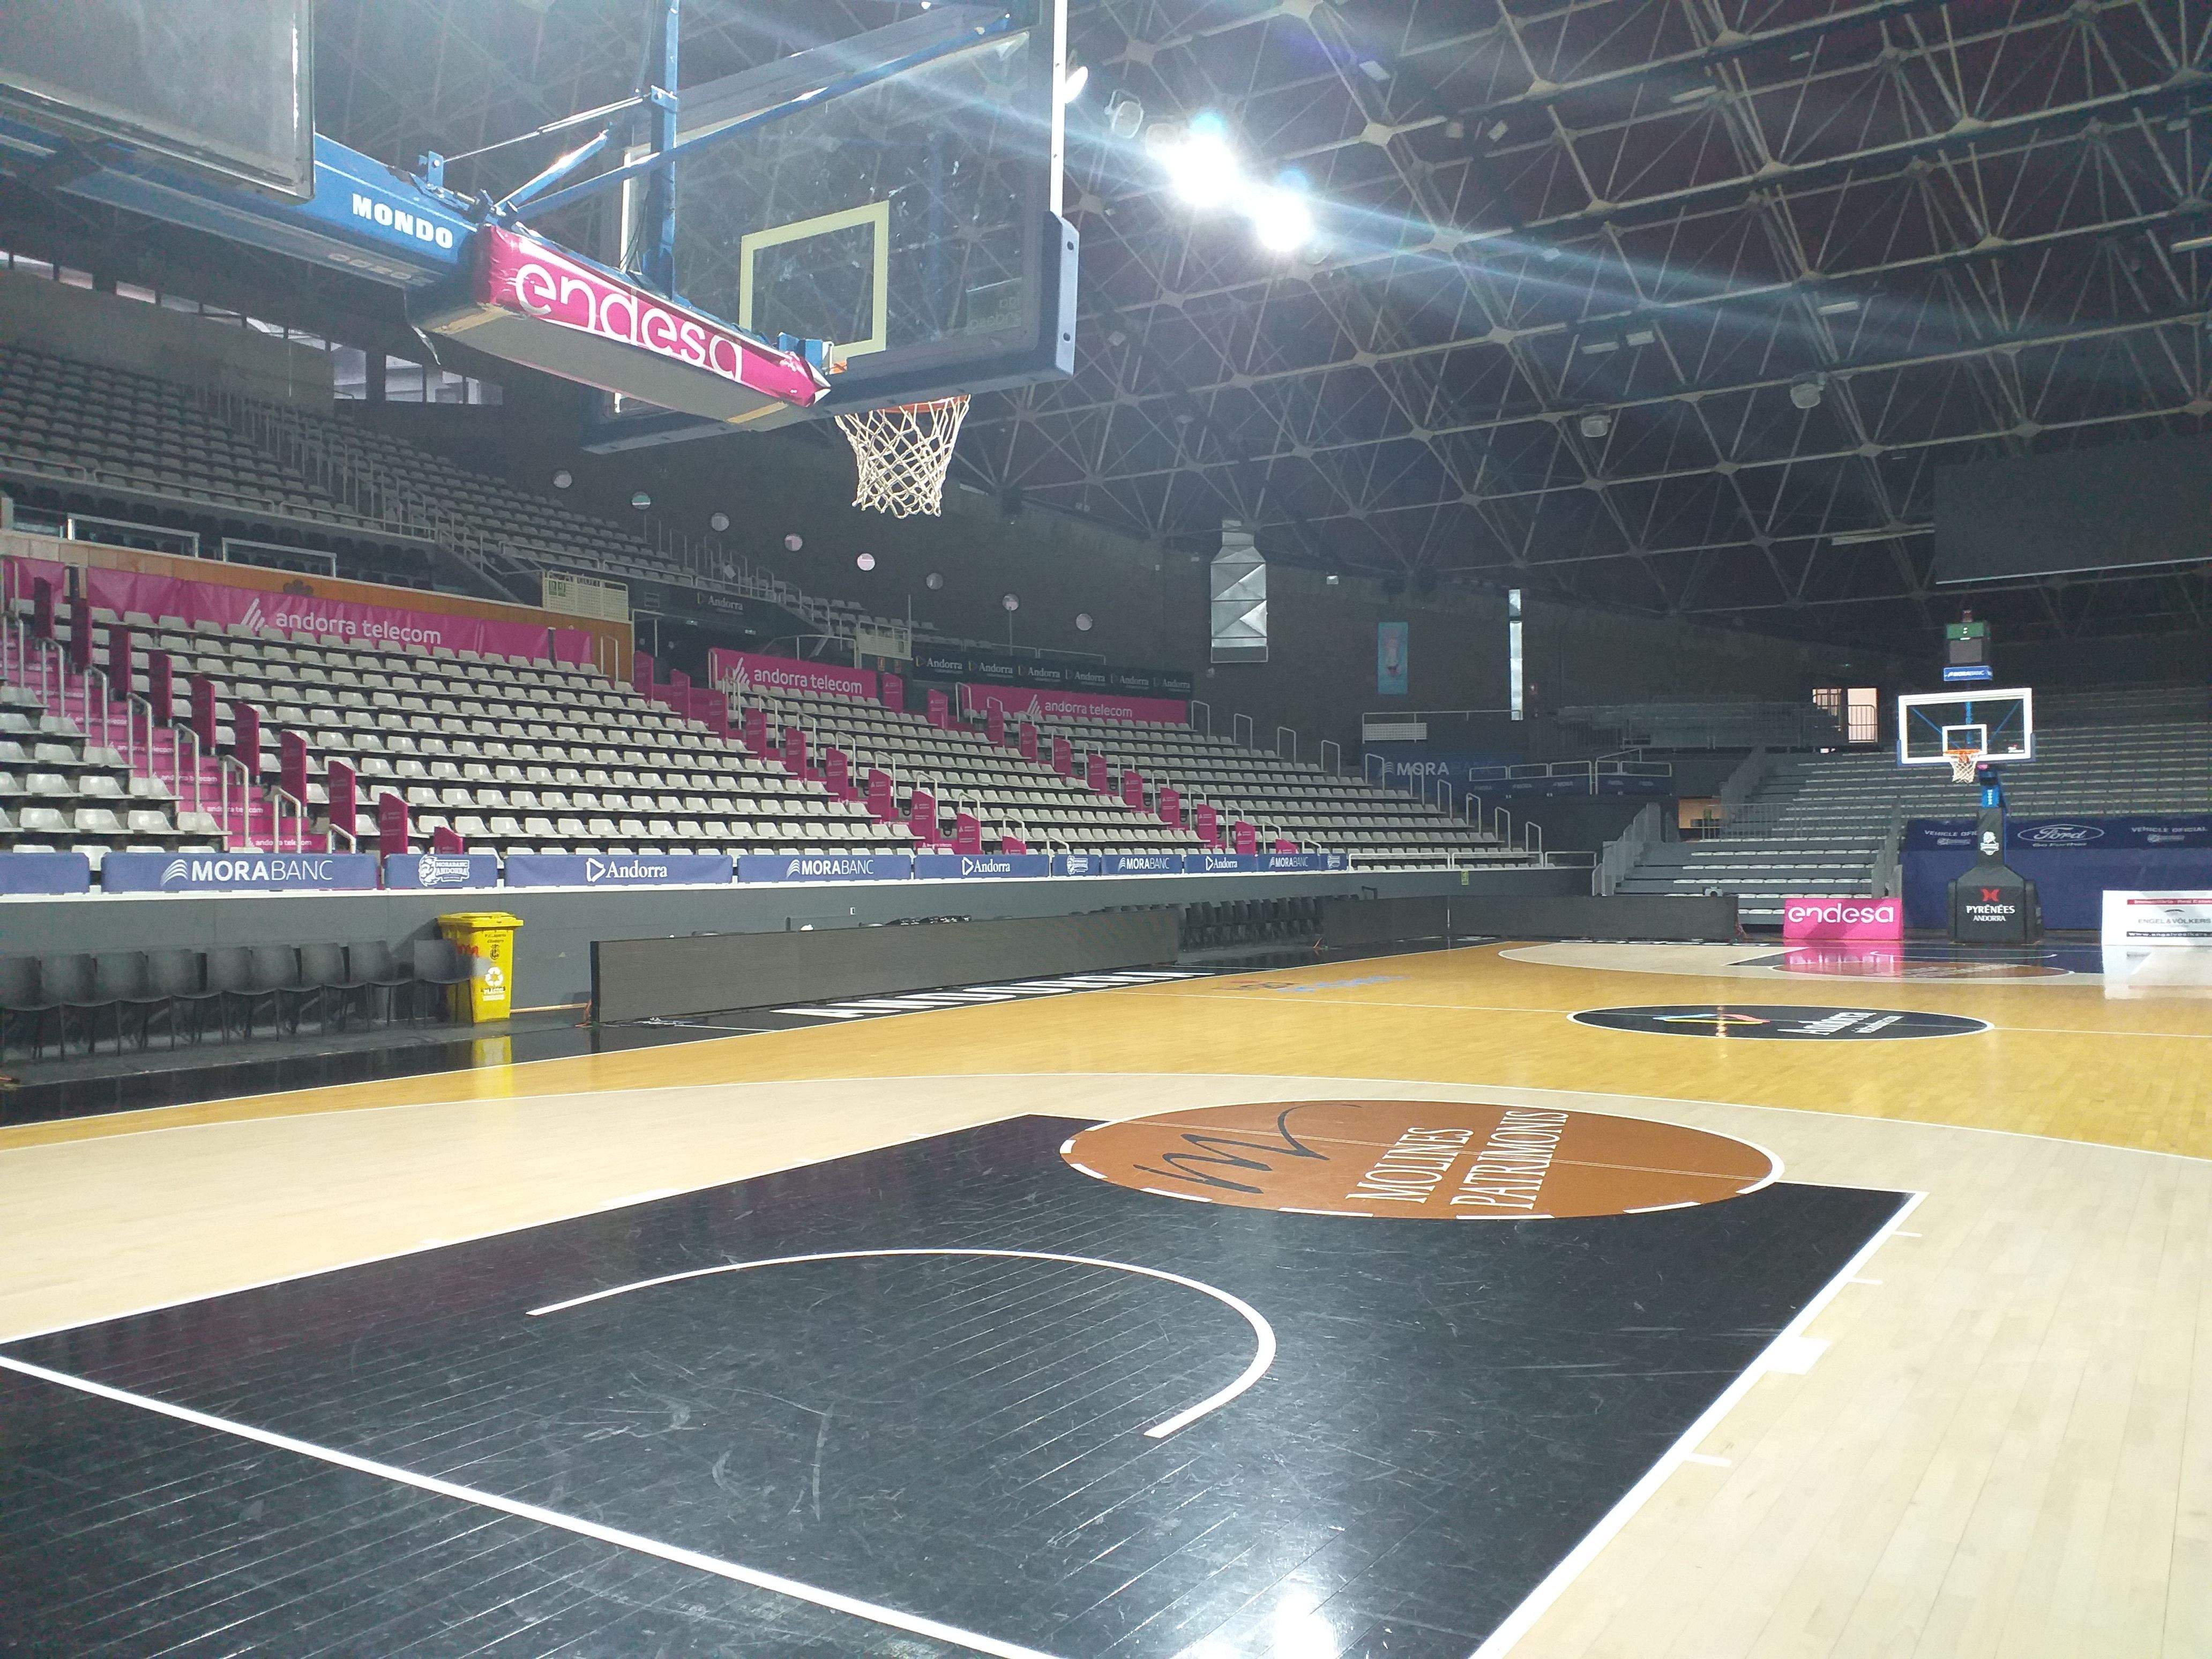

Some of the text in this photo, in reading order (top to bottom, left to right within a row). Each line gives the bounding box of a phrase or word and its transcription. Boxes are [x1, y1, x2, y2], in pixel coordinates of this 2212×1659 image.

[352, 193, 453, 249] MONDO
[515, 264, 743, 382] endesa
[708, 595, 743, 611] Andorra
[275, 611, 442, 645] andorra telecom
[926, 657, 963, 670] Andorra
[979, 662, 1014, 675] Andorra
[1028, 667, 1060, 679] Andorra
[1074, 671, 1106, 683] Andorra
[1119, 675, 1149, 686] Andorra
[753, 668, 863, 694] andorra telecom
[1162, 678, 1191, 689] Andorra
[1045, 700, 1133, 718] andorra telecom
[1396, 761, 1450, 776] MORA
[2034, 827, 2088, 840] Ford
[605, 860, 668, 878] Andorra
[802, 860, 875, 875] MORABANC
[973, 858, 1011, 873] Andorra
[1126, 857, 1170, 870] MORABANC
[1213, 857, 1238, 869] Andorra
[1275, 857, 1309, 868] MORABANC
[191, 860, 333, 881] MORABANC
[1788, 903, 1894, 923] endesa
[769, 972, 1215, 1018] ANDORRA
[1345, 1127, 1474, 1204] MOLINES
[1450, 1110, 1571, 1210] PATRIMONIS
